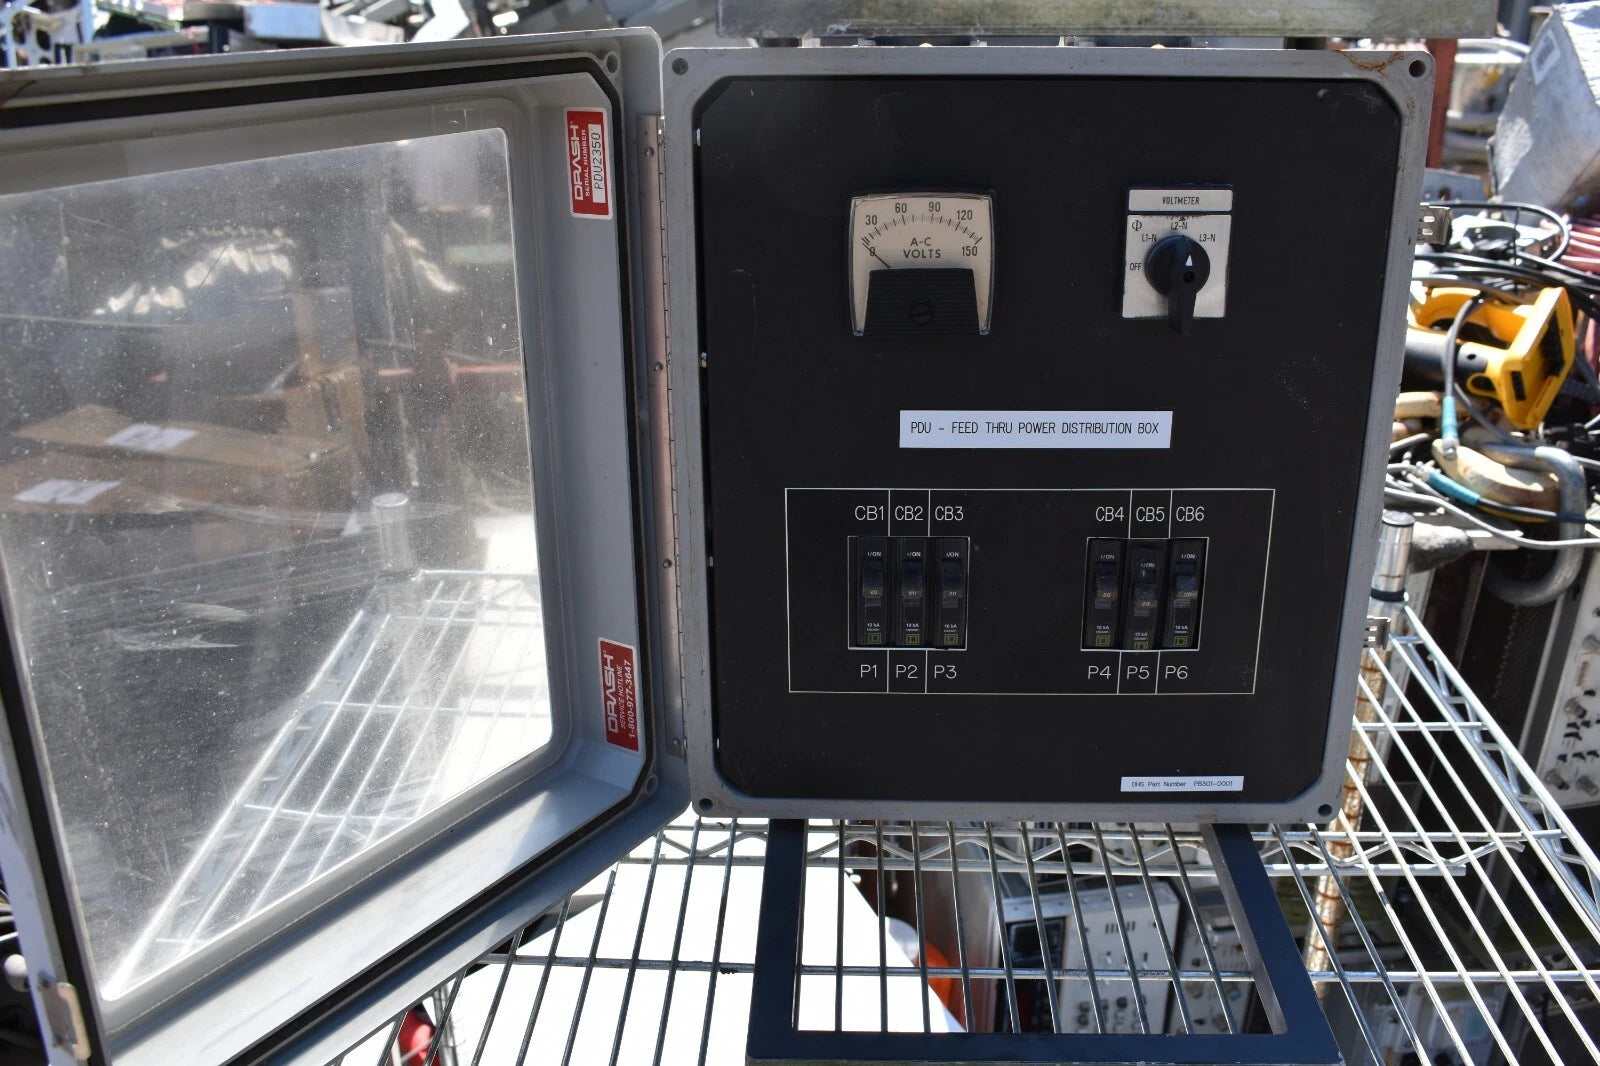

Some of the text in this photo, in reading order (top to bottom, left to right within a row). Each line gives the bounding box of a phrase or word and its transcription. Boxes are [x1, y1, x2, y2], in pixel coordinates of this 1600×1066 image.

[570, 124, 583, 200] DRASH
[591, 132, 603, 190] PDU2350
[894, 202, 907, 213] 60
[928, 201, 941, 212] 90
[1162, 196, 1200, 205] VOLTMETER
[865, 214, 878, 226] 30
[956, 209, 973, 221] 120
[1170, 221, 1188, 230] L2-N
[910, 237, 932, 247] A-C
[1141, 233, 1157, 242] L1-N
[1199, 233, 1216, 242] L3-N
[903, 249, 941, 259] VOLTS
[961, 245, 978, 257] 150
[1129, 262, 1142, 271] OFF
[910, 421, 932, 434] PDU
[951, 421, 979, 434] FEED
[985, 421, 1013, 434] THRU
[1018, 421, 1056, 434] POWER
[1061, 421, 1132, 434] DISTRIBUTION
[1137, 421, 1160, 434] BOX
[854, 505, 884, 521] CB1
[894, 505, 924, 521] CB2
[934, 506, 964, 521] CB3
[1095, 506, 1125, 522] CB4
[1135, 506, 1165, 522] CB5
[1175, 506, 1205, 522] CB6
[860, 664, 877, 678] P1
[895, 664, 918, 679] P2
[934, 664, 957, 679] P3
[1087, 665, 1111, 679] P4
[1126, 665, 1150, 680] P5
[1164, 665, 1188, 680] P6
[603, 653, 618, 733] DRASH
[616, 664, 626, 729] SERVICE HOTLINE
[624, 660, 636, 738] 1-800-977-3647
